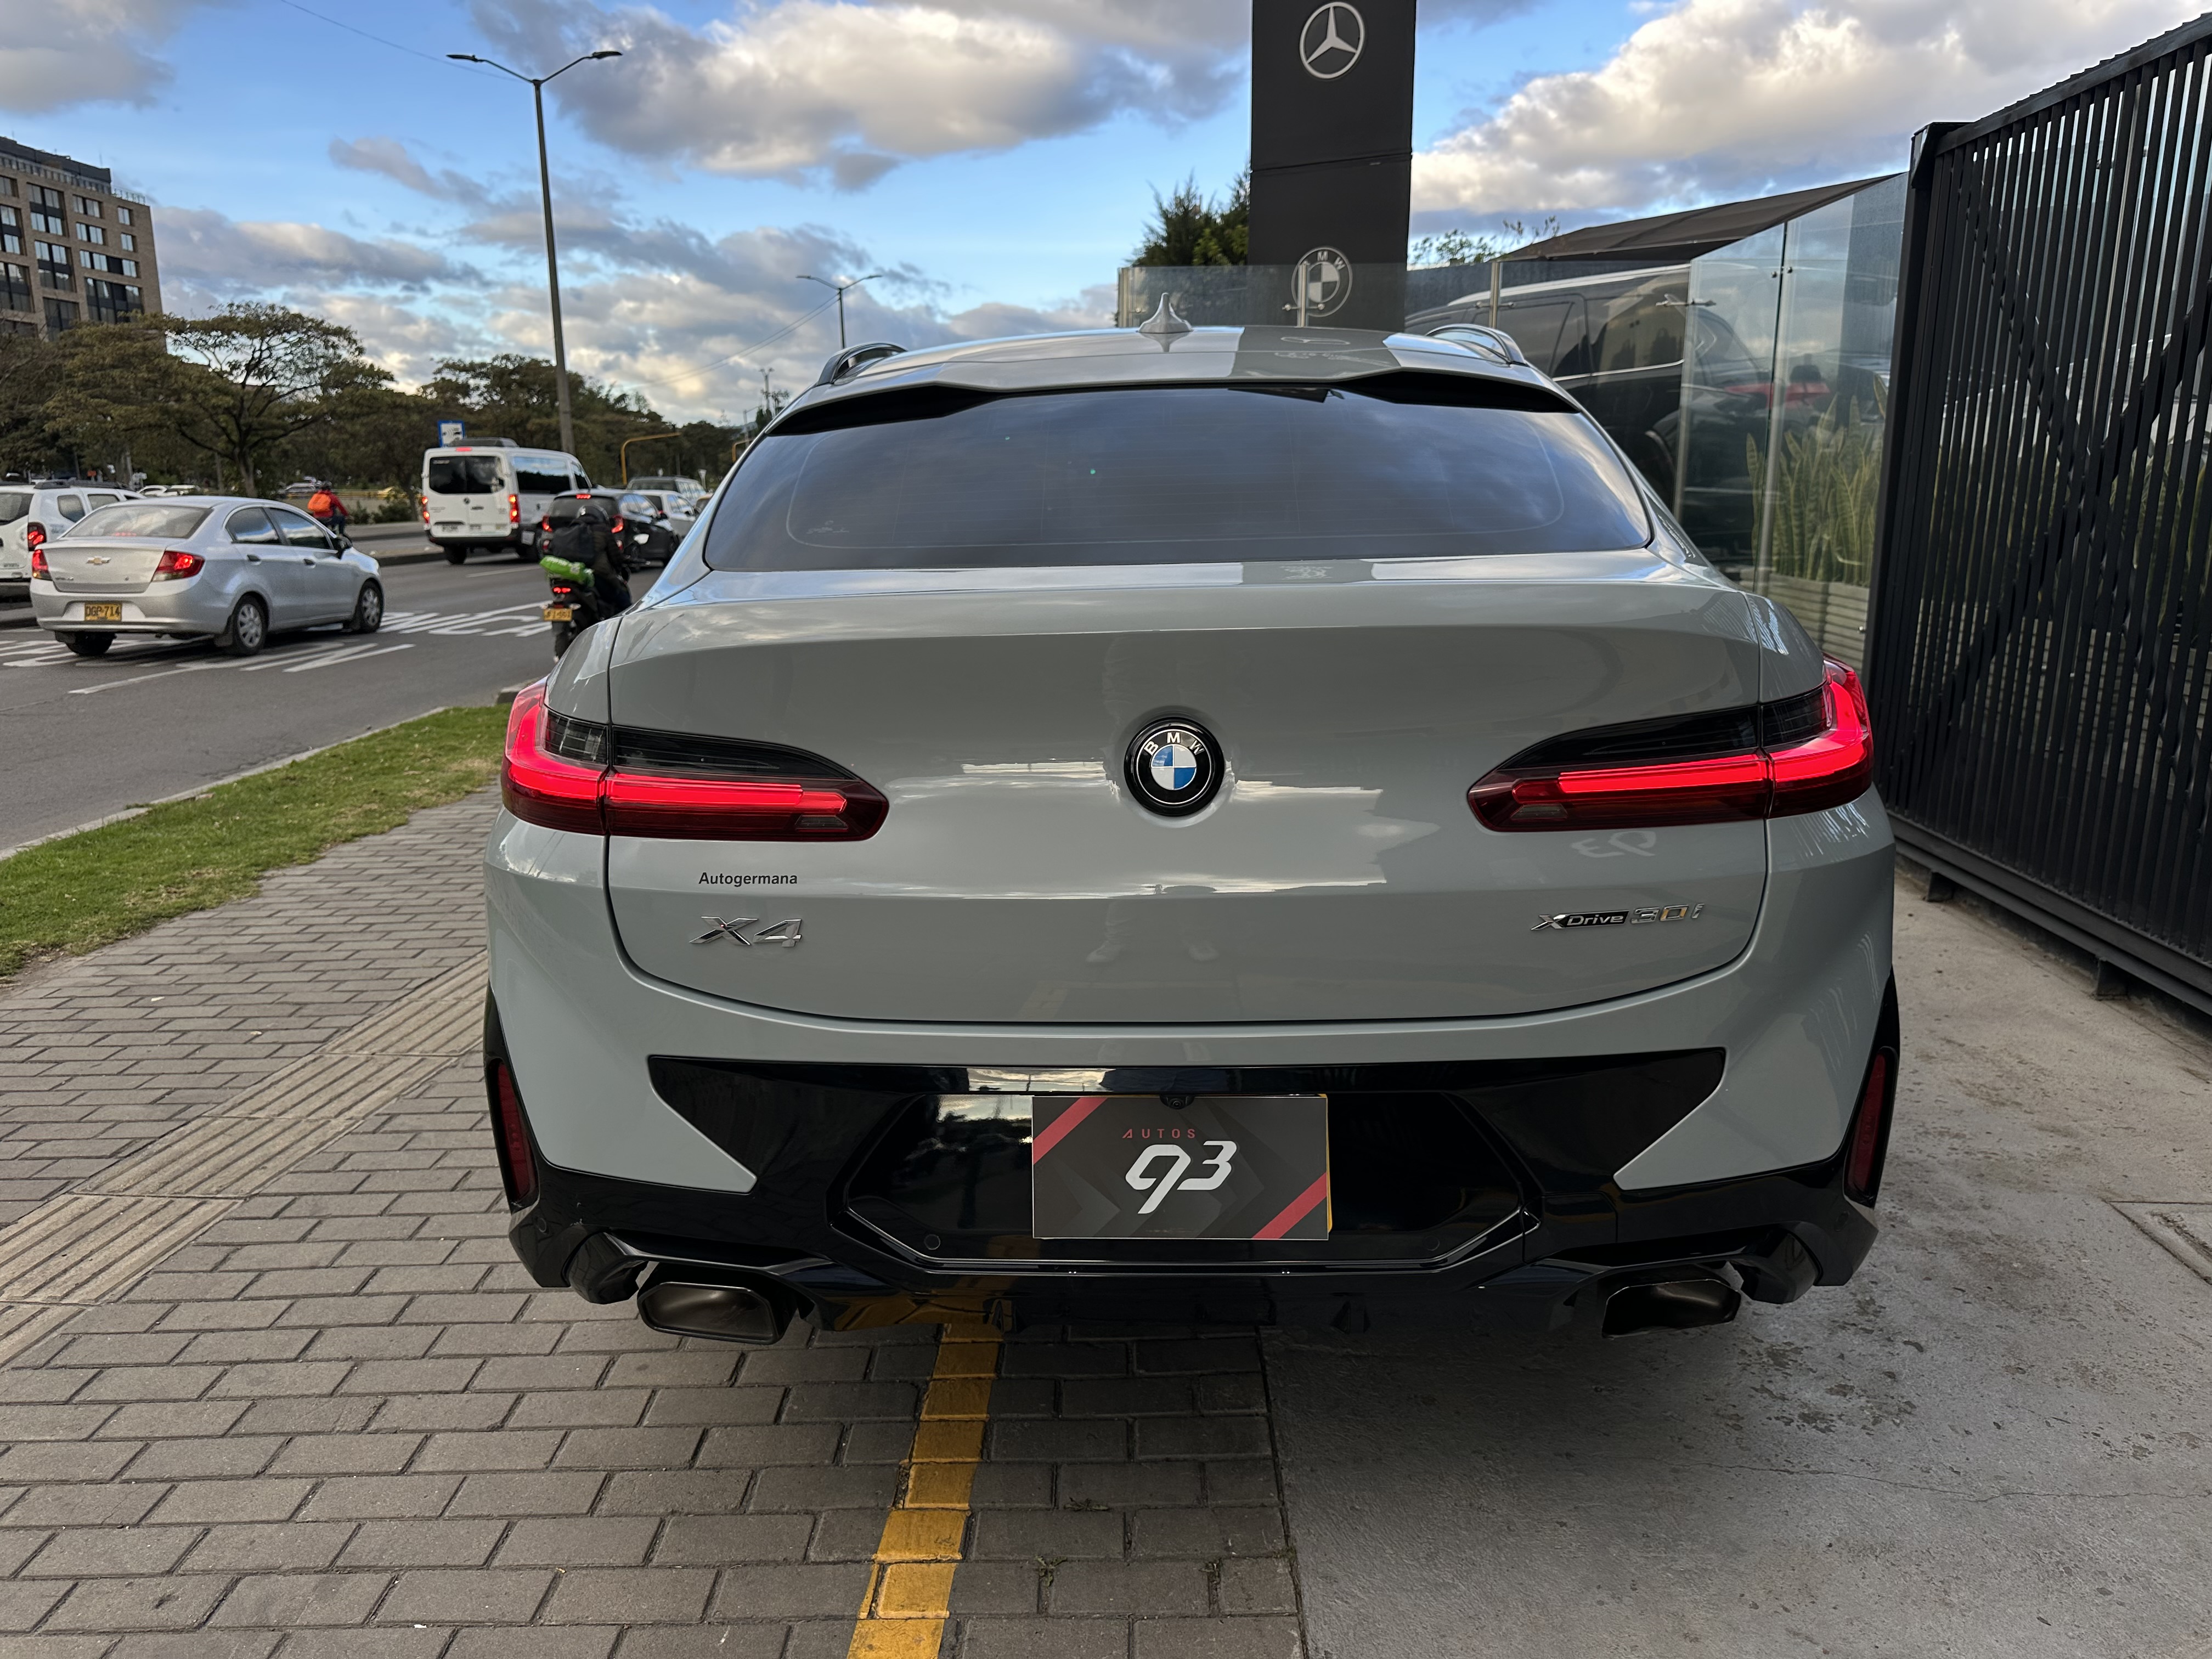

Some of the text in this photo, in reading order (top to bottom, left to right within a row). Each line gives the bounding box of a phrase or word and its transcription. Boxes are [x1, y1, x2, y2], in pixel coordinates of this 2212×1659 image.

[1304, 251, 1346, 270] MW
[1144, 732, 1204, 755] BMW
[698, 872, 798, 887] Autogermana
[689, 916, 803, 948] X4
[1122, 1128, 1197, 1139] AUTOS
[1125, 1140, 1238, 1214] 93
